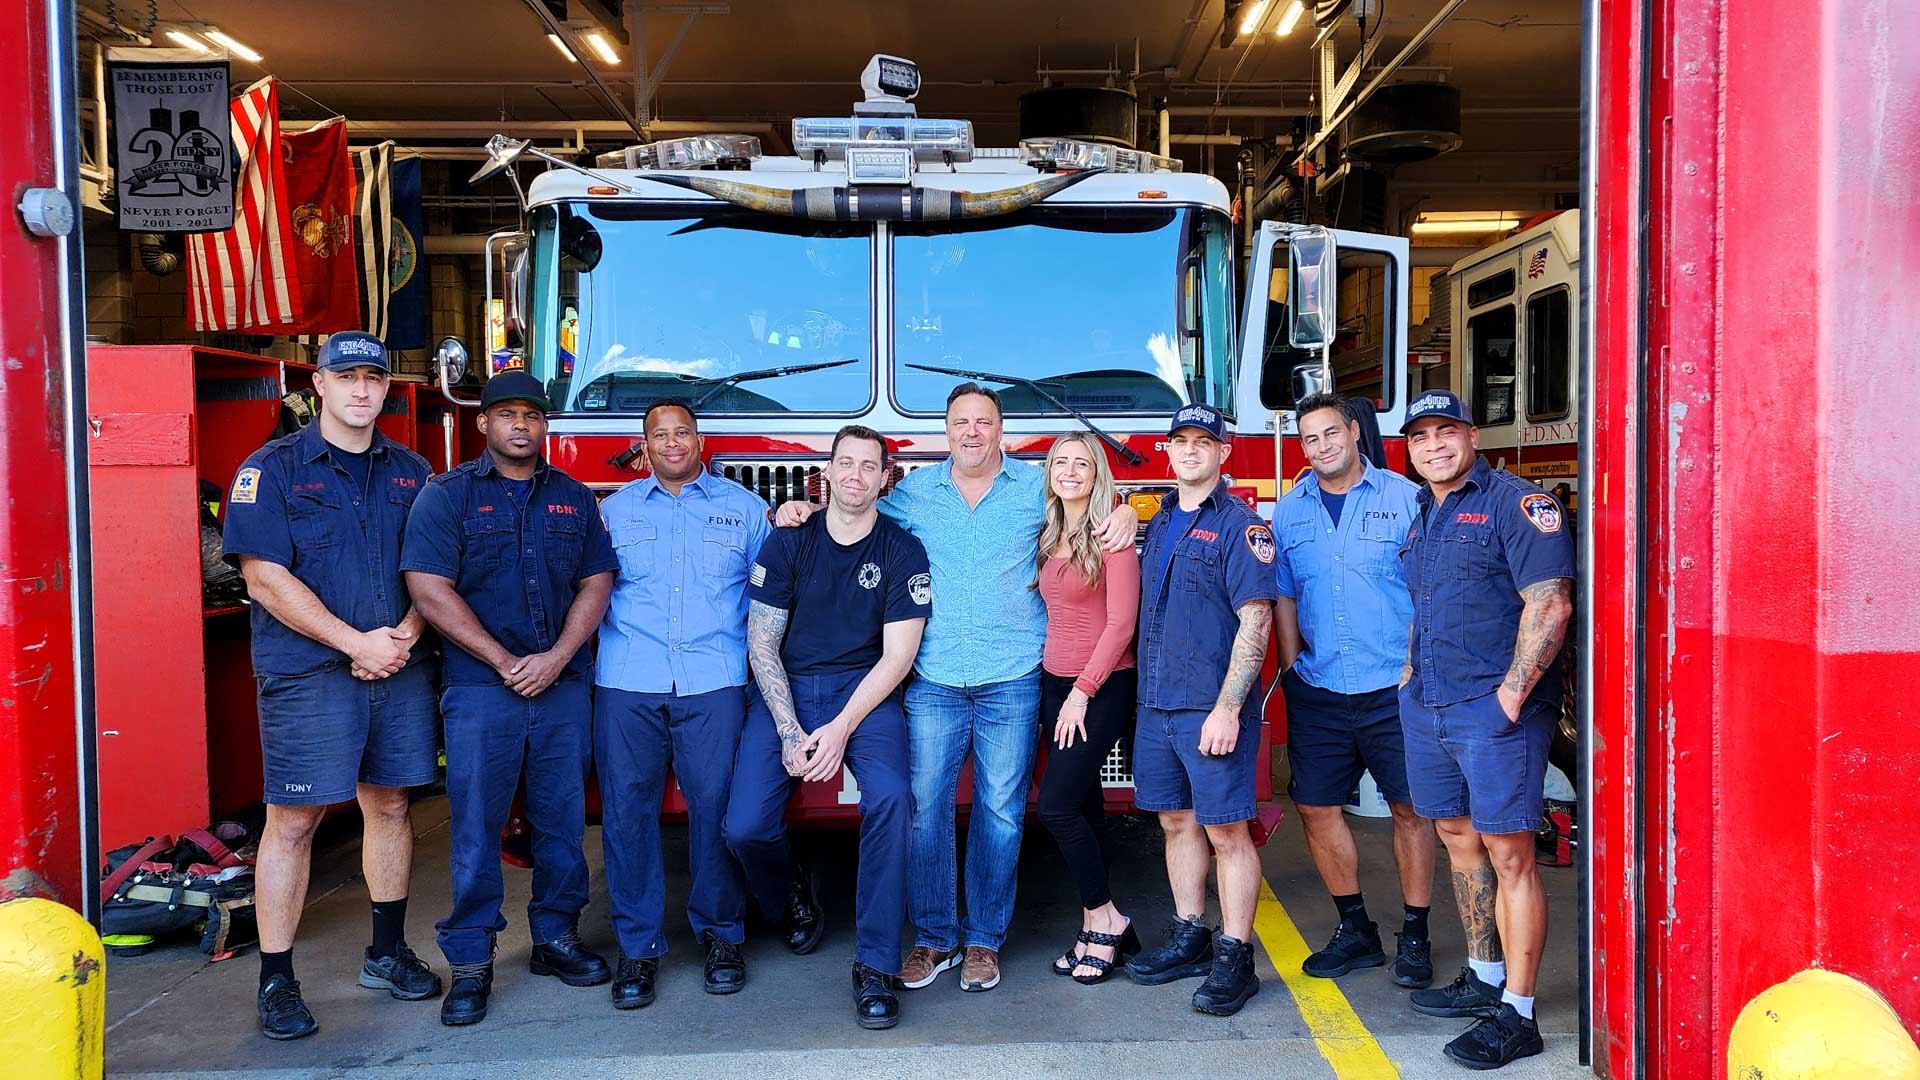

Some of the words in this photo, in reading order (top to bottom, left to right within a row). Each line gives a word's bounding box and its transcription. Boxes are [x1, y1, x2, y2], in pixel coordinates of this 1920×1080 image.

[117, 70, 224, 82] REMEMBERING
[125, 83, 175, 95] THOSE
[179, 83, 214, 95] LOST
[178, 147, 220, 156] FDNY
[141, 161, 171, 175] NEVER
[173, 161, 215, 175] FORGET
[123, 207, 172, 217] NEVER
[175, 205, 231, 217] FORGET
[142, 219, 171, 228] 2001
[187, 217, 214, 228] 2021
[1154, 441, 1172, 452] ST
[392, 477, 416, 488] FDN
[548, 504, 578, 514] FDNY
[1365, 511, 1399, 521] FDNY
[1455, 512, 1489, 524] FDNY
[708, 516, 741, 528] FDNY
[1190, 528, 1218, 542] FDNY
[285, 783, 313, 793] FDNY
